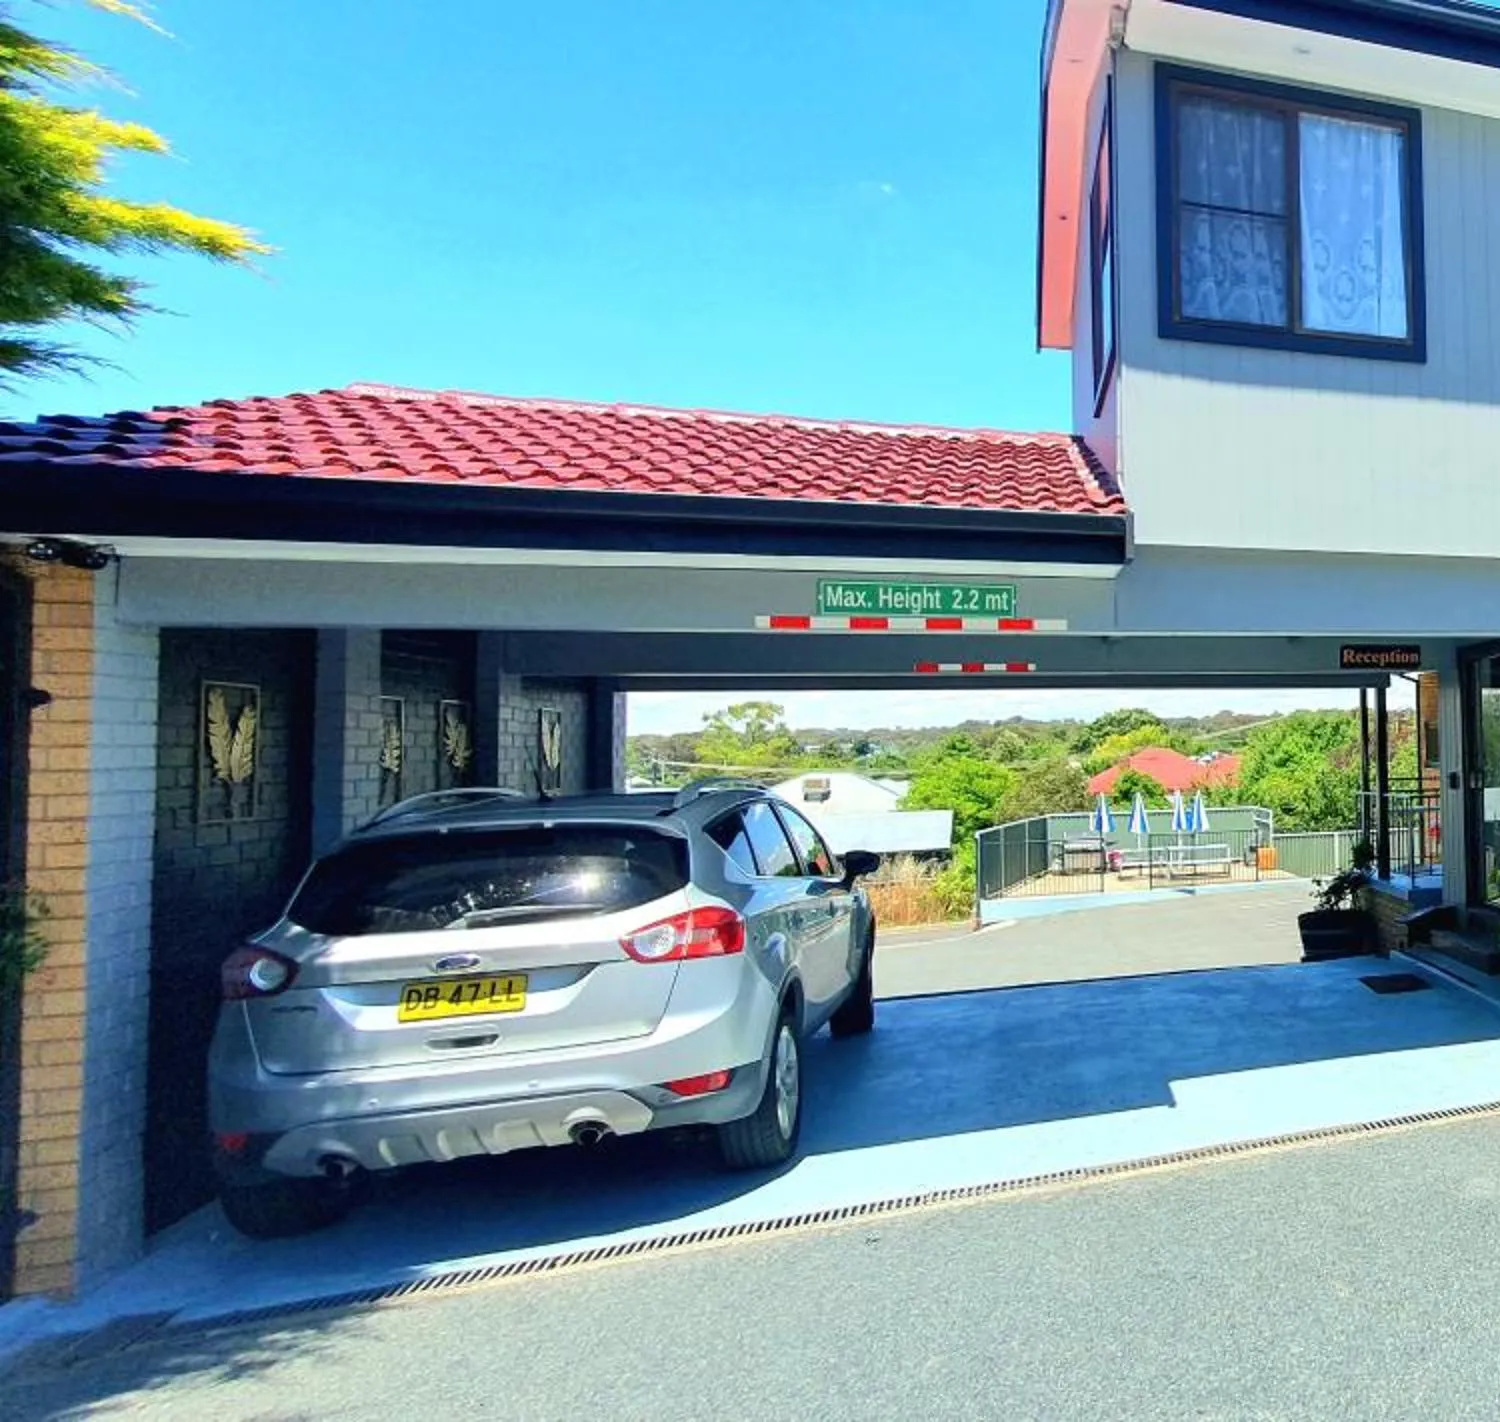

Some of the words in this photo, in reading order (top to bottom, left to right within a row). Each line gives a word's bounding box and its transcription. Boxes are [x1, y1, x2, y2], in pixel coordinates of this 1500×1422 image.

[825, 585, 872, 609] Max.
[879, 587, 941, 614] Height
[951, 588, 979, 611] 2.2
[985, 592, 1009, 611] mt
[1343, 649, 1419, 667] Reception
